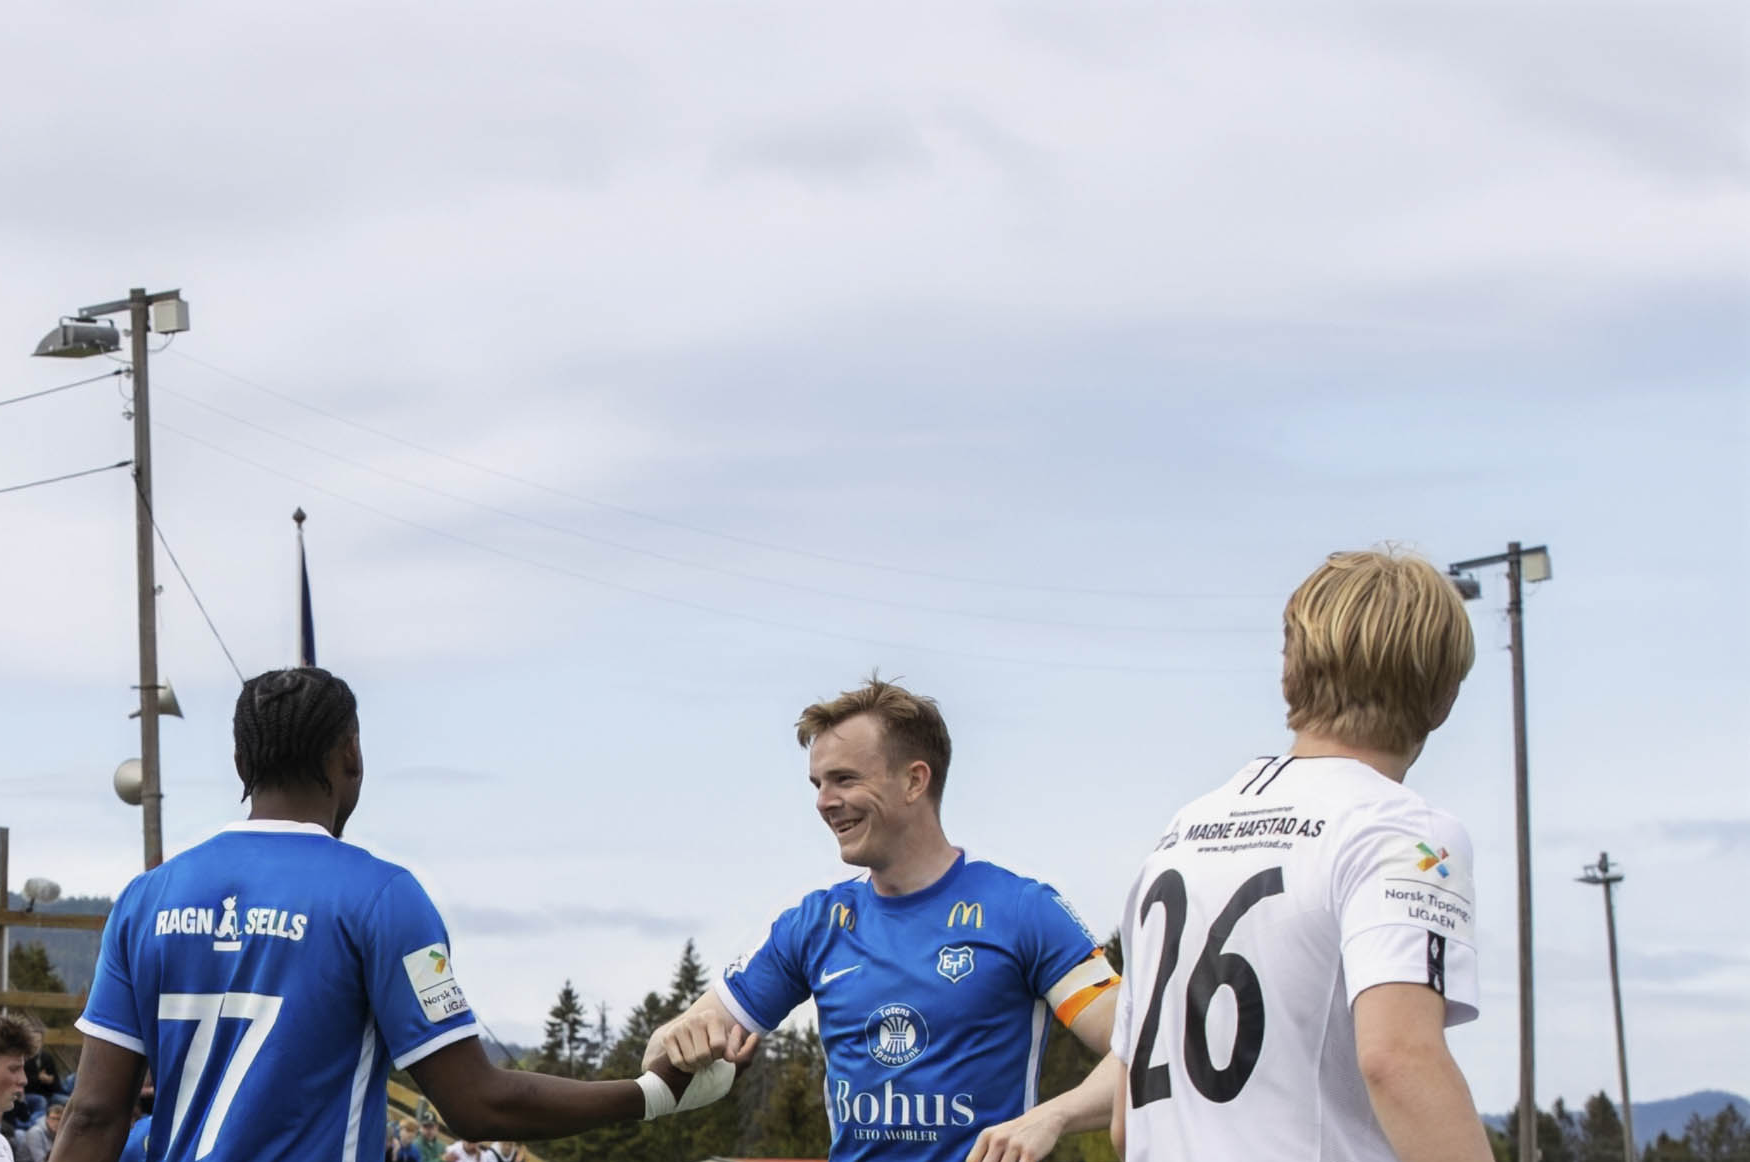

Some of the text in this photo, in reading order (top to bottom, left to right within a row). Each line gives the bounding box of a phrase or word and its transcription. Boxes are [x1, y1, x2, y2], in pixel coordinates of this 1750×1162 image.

[1184, 822, 1235, 841] MAGNE
[1234, 817, 1297, 838] HAFSTAD
[1384, 889, 1426, 903] Norsk
[155, 908, 308, 941] RAGN SELLS
[1408, 907, 1456, 930] LIGAEN
[423, 990, 452, 1008] Norsk
[1129, 866, 1286, 1110] 26
[878, 1006, 910, 1018] Totens
[872, 1044, 921, 1065] Sparebank
[157, 991, 284, 1162] 77
[836, 1079, 976, 1127] Bohus
[854, 1128, 880, 1141] LETO
